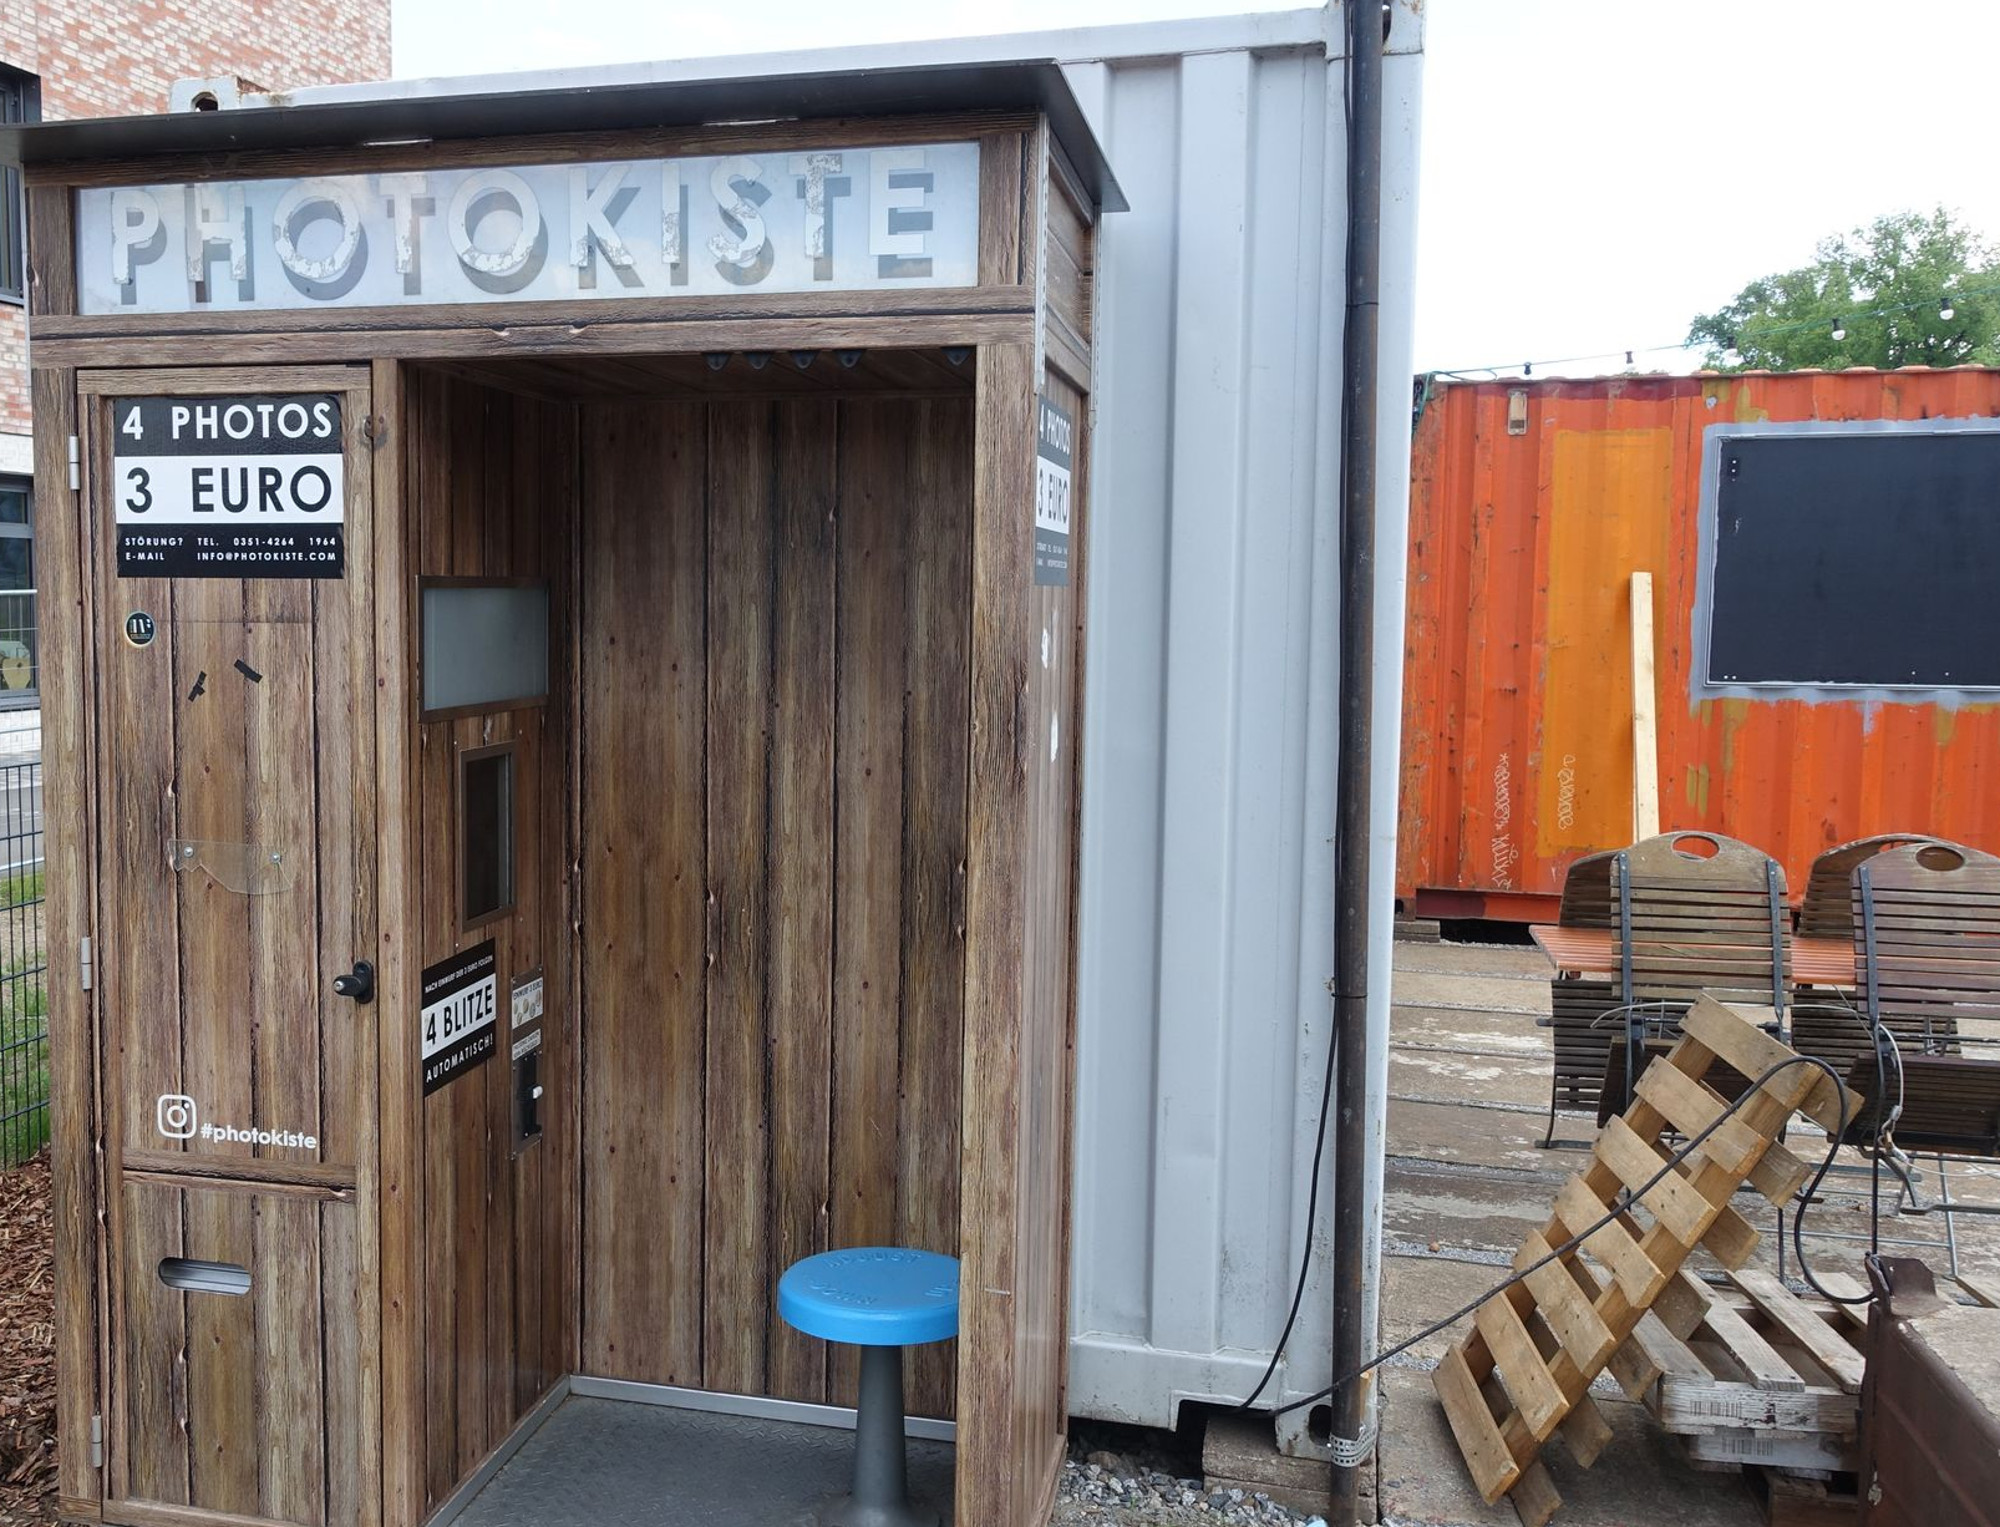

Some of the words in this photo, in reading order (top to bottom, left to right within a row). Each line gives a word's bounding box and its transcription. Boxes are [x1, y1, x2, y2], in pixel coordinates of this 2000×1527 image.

[109, 149, 936, 306] PHOTOKISTE
[122, 405, 144, 440] 4
[171, 402, 333, 440] PHOTOS
[125, 466, 153, 514] 3
[191, 465, 332, 513] EURO
[124, 535, 184, 547] STÖRUNG?
[197, 537, 220, 547] TEL.
[233, 537, 295, 547] 0351-4264
[309, 537, 337, 546] 1964
[125, 552, 165, 561] E-MAIL
[197, 552, 337, 562] INFO@PHOTOKISTE.COM
[426, 1012, 437, 1046] 4
[443, 983, 493, 1039] BLITZE
[425, 1032, 494, 1084] AUTOMATISCH!
[200, 1122, 318, 1149] #photokiste
